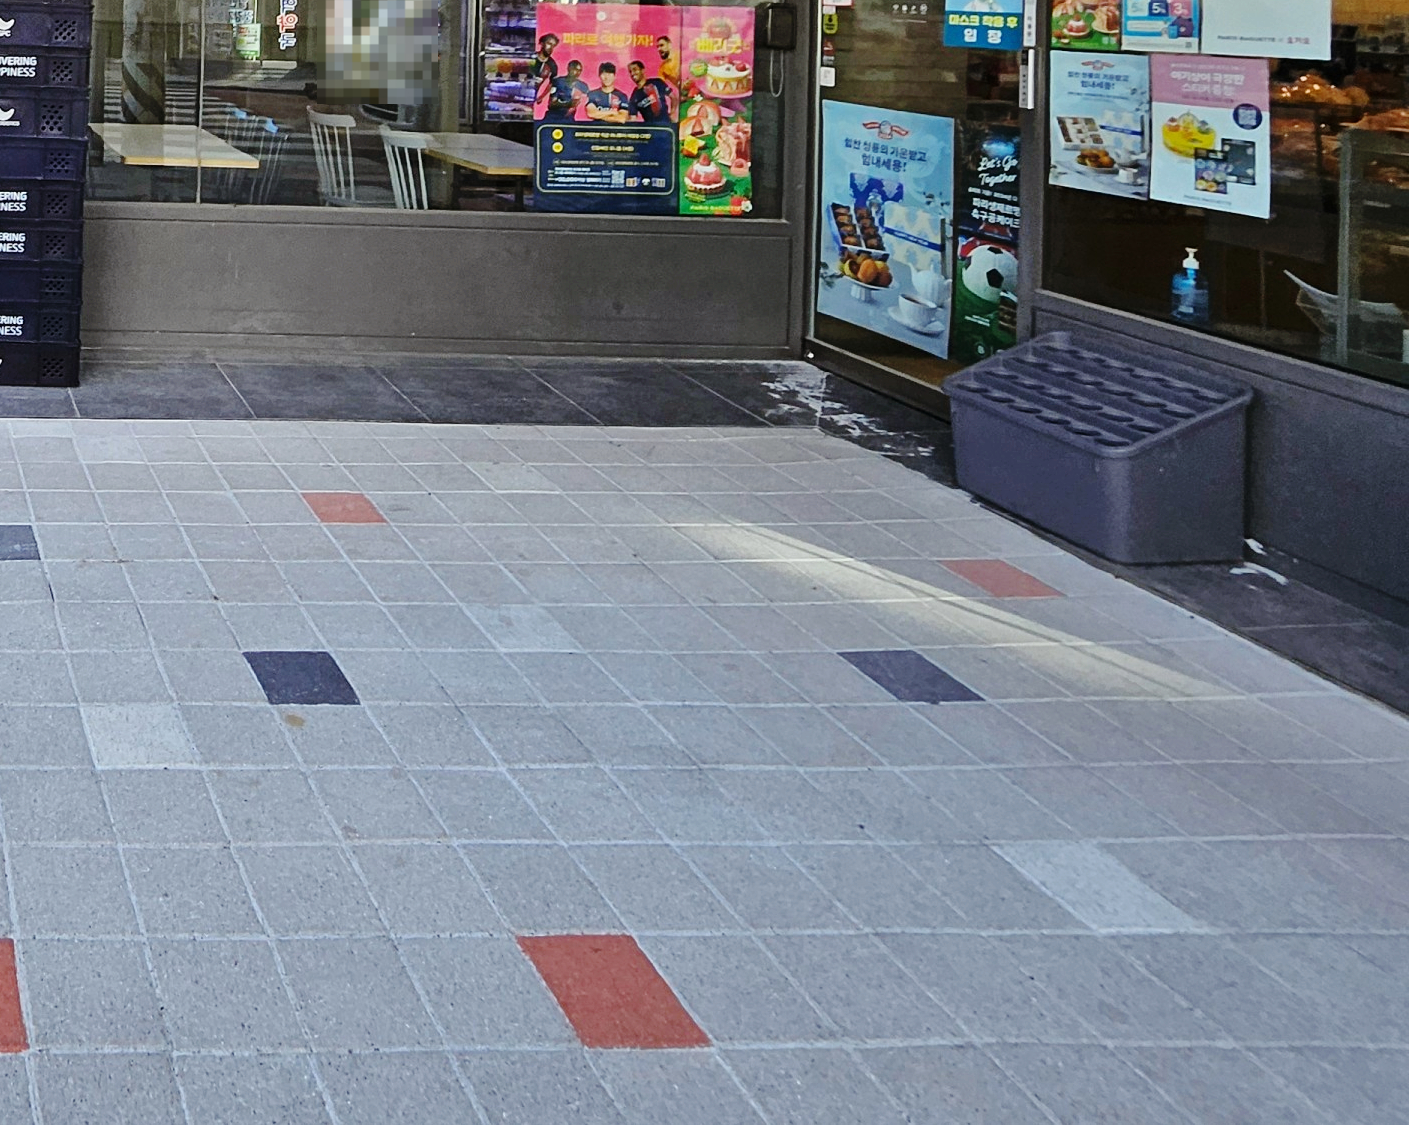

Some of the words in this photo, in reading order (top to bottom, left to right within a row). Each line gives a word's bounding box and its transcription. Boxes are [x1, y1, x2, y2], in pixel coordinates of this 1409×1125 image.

[948, 14, 980, 26] 마스크
[1006, 16, 1018, 28] 후
[861, 153, 907, 173] 힘내세용!
[977, 156, 1001, 172] Let's
[1002, 155, 1019, 172] Go
[978, 173, 1018, 187] Together
